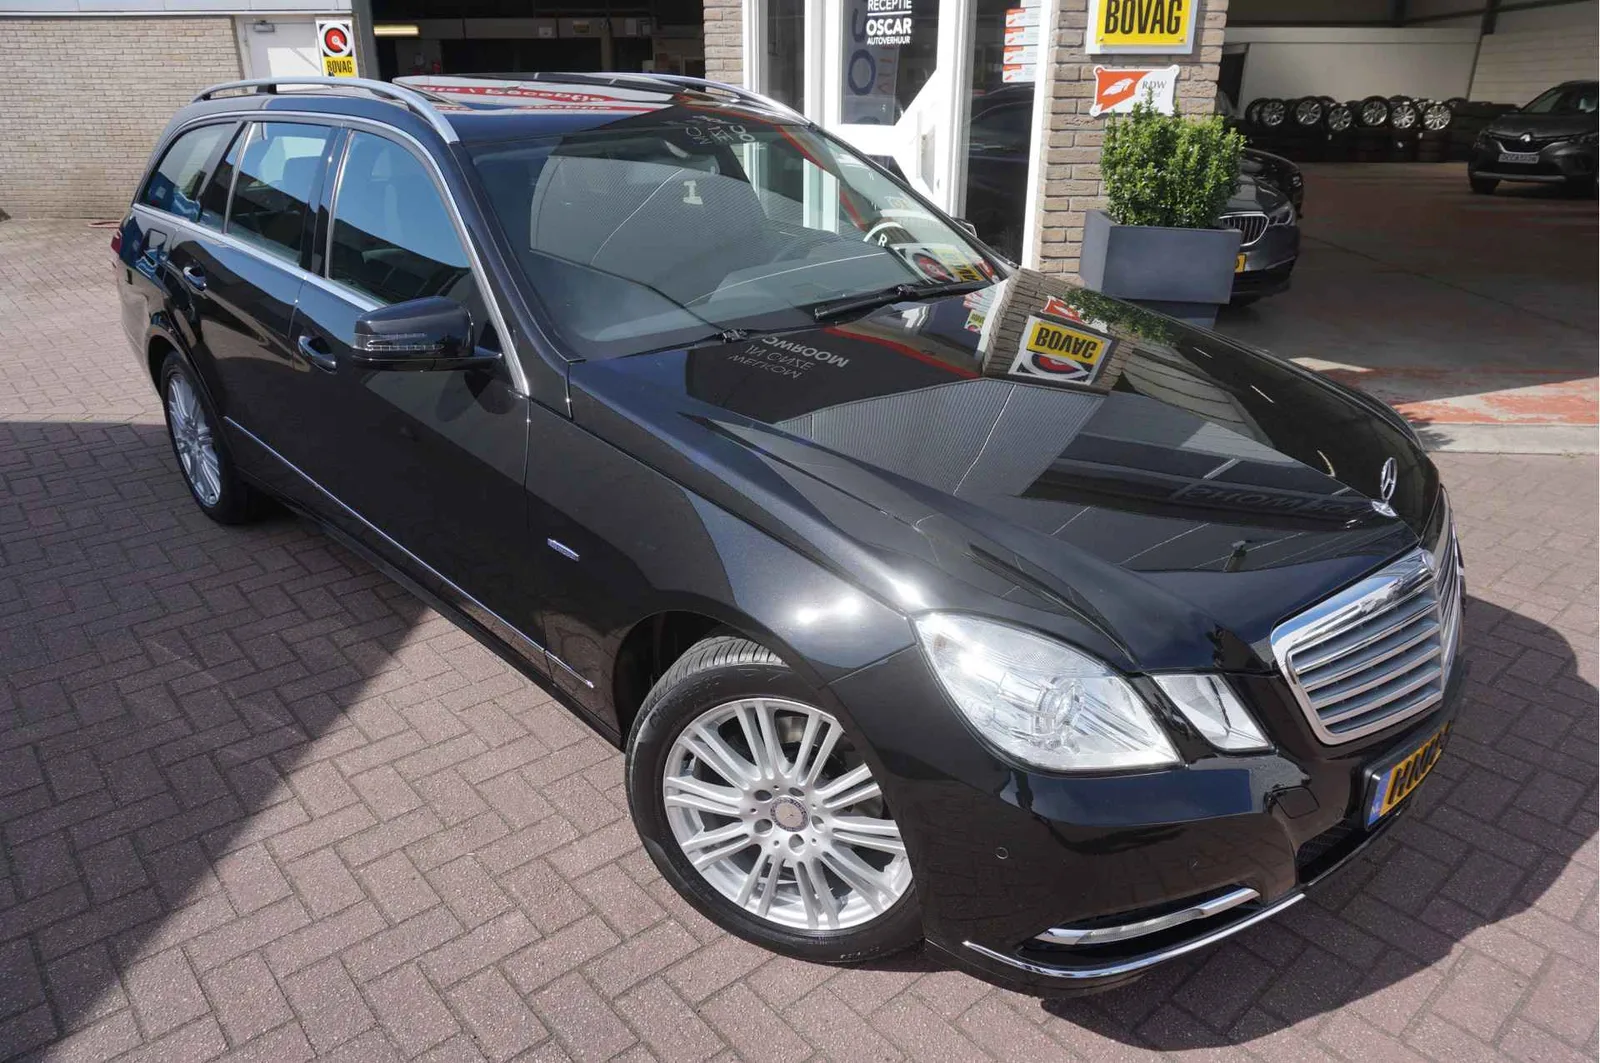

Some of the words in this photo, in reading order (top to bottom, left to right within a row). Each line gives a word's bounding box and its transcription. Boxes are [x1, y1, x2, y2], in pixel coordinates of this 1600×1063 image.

[867, 0, 912, 11] RECEPTIE
[1104, 0, 1183, 35] BOVAG
[866, 17, 912, 36] OSCAR
[326, 60, 354, 73] BOVAG
[1141, 79, 1167, 89] RDW
